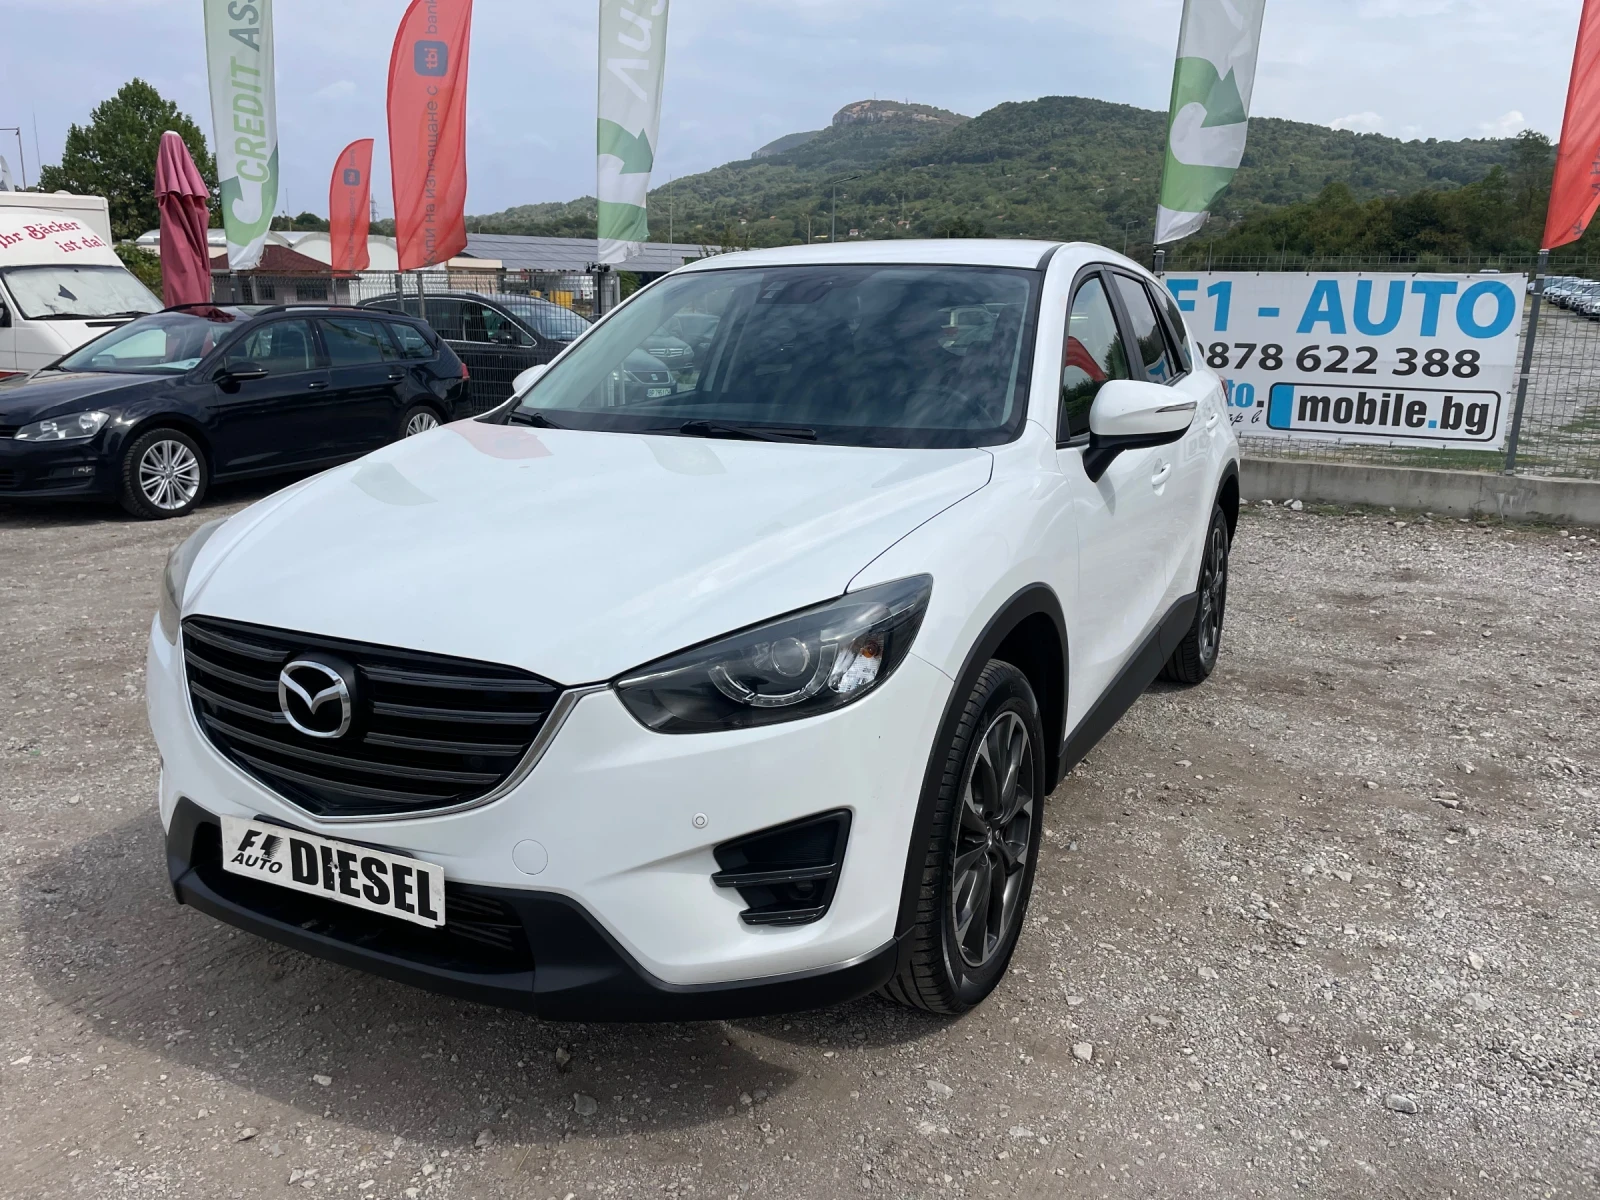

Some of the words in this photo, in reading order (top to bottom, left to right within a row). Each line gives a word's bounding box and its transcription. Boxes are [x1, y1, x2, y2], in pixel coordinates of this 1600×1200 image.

[228, 0, 260, 52] AS
[424, 47, 438, 69] tbi
[230, 56, 270, 183] CREDIT
[425, 203, 436, 223] на
[23, 221, 81, 240] Bäcker
[55, 241, 82, 253] ist
[1166, 279, 1232, 332] F1
[1258, 307, 1280, 317] -
[1295, 279, 1516, 339] AUTO
[1295, 344, 1378, 375] 622
[1391, 347, 1481, 378] 388
[1297, 391, 1490, 436] mobile.bg
[230, 852, 283, 874] AUTO
[289, 837, 438, 922] DIESEL
